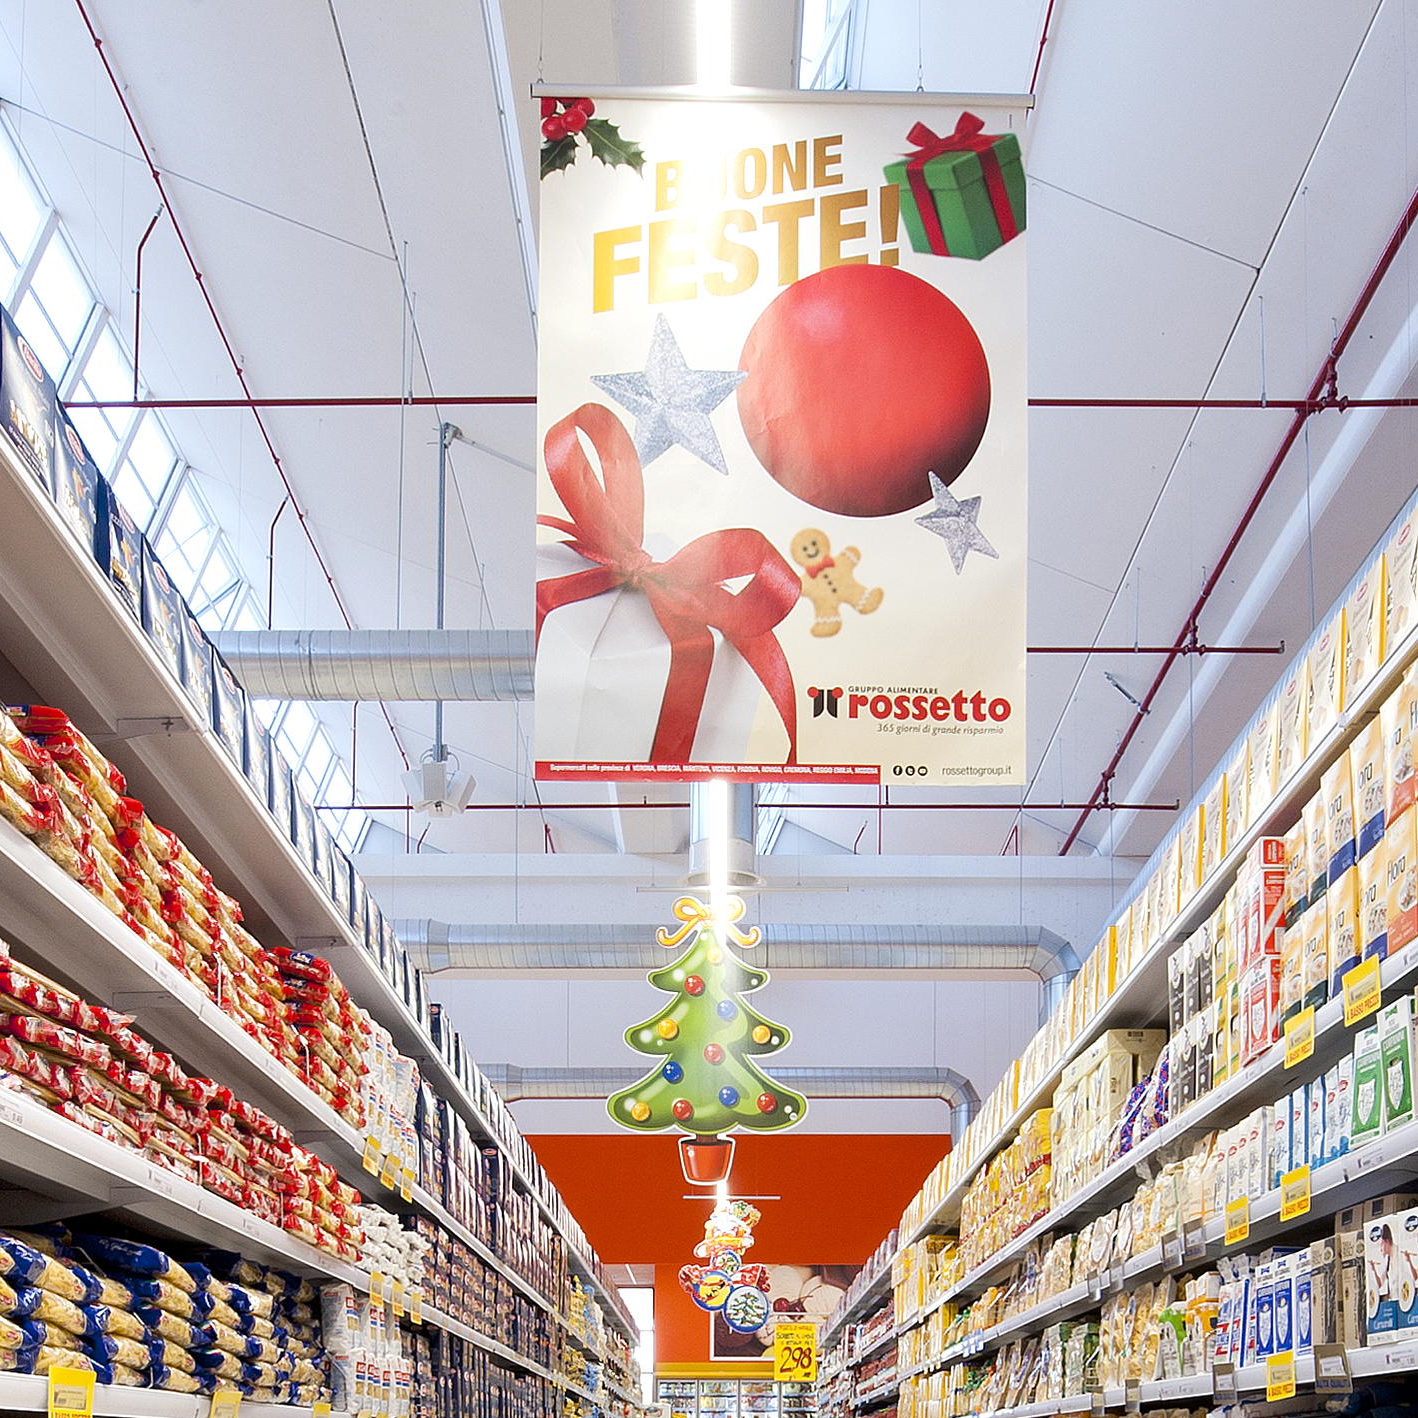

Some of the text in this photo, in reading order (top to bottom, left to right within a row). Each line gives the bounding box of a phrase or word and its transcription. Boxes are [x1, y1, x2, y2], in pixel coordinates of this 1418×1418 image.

[593, 183, 900, 314] FESTE!
[848, 686, 939, 695] GRUPPO ALIMENTARE
[848, 690, 1012, 722] rossetto
[877, 724, 1004, 737] 365 giorni di grande risparmio
[942, 766, 1012, 777] rossettogroup.it
